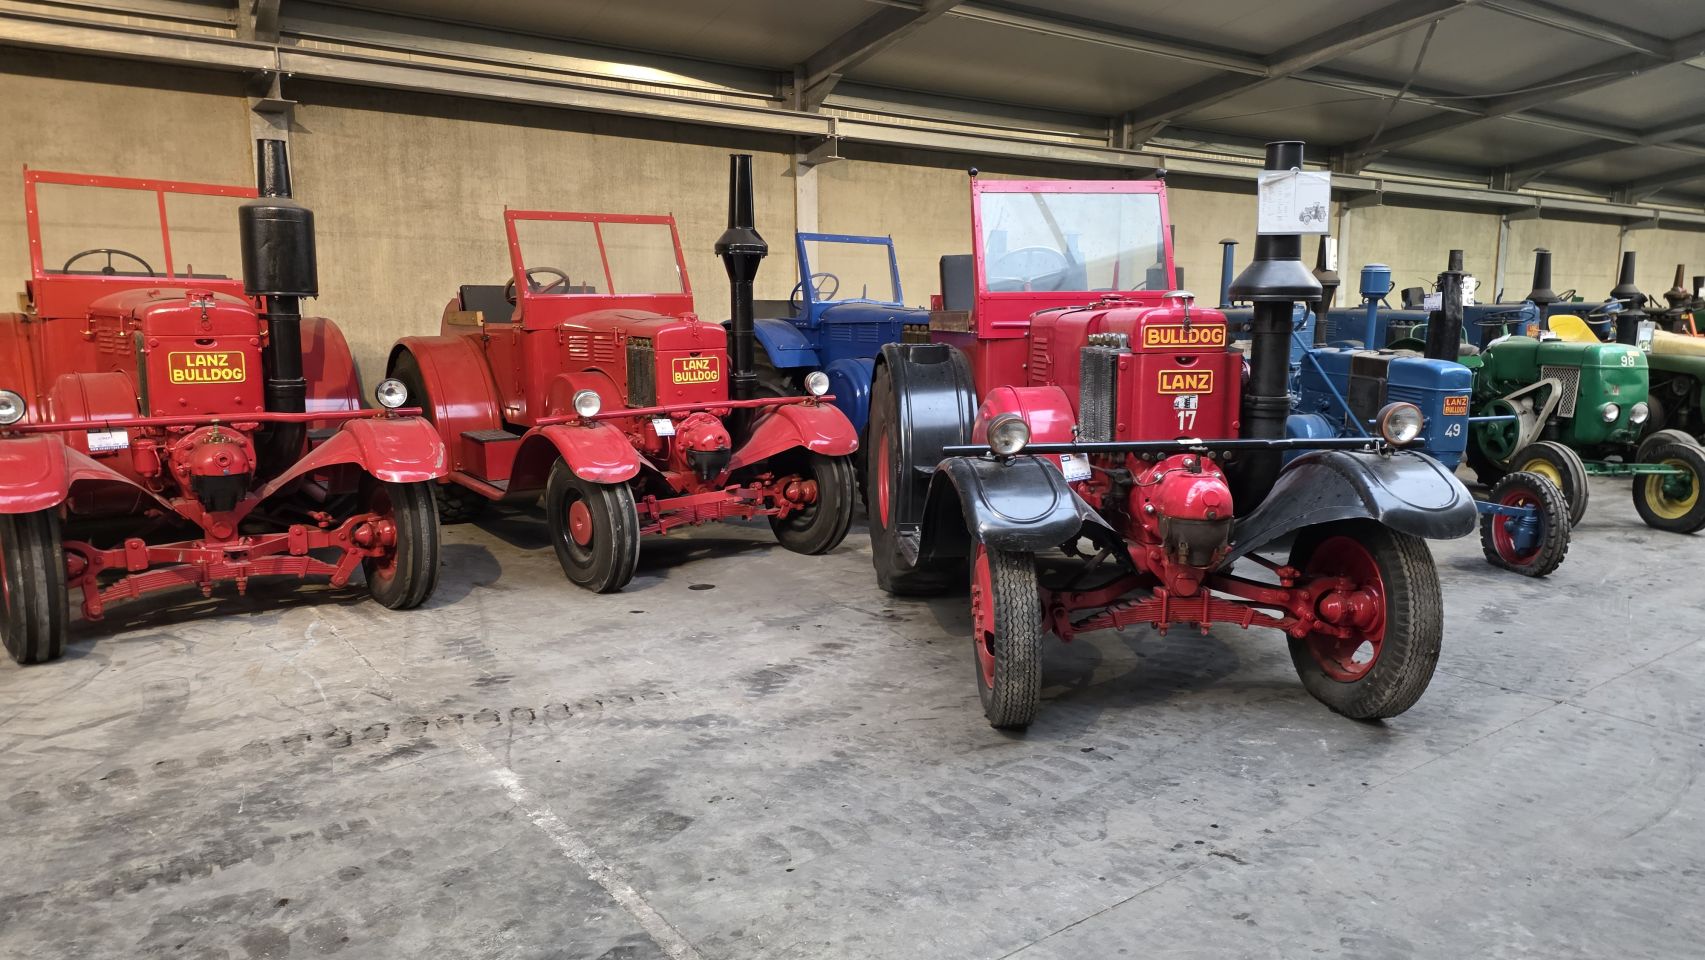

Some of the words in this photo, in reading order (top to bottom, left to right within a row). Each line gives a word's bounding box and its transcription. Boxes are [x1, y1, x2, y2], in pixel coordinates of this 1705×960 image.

[1147, 328, 1223, 344] BULLDOG
[186, 354, 229, 367] LANZ
[683, 360, 710, 370] LANZ
[1620, 355, 1635, 367] 98
[173, 368, 242, 381] BULLDOG
[675, 370, 717, 382] BULLDOG
[1162, 374, 1209, 390] LANZ
[1446, 398, 1467, 406] LANZ
[1177, 410, 1197, 431] 17
[1444, 423, 1461, 437] 49
